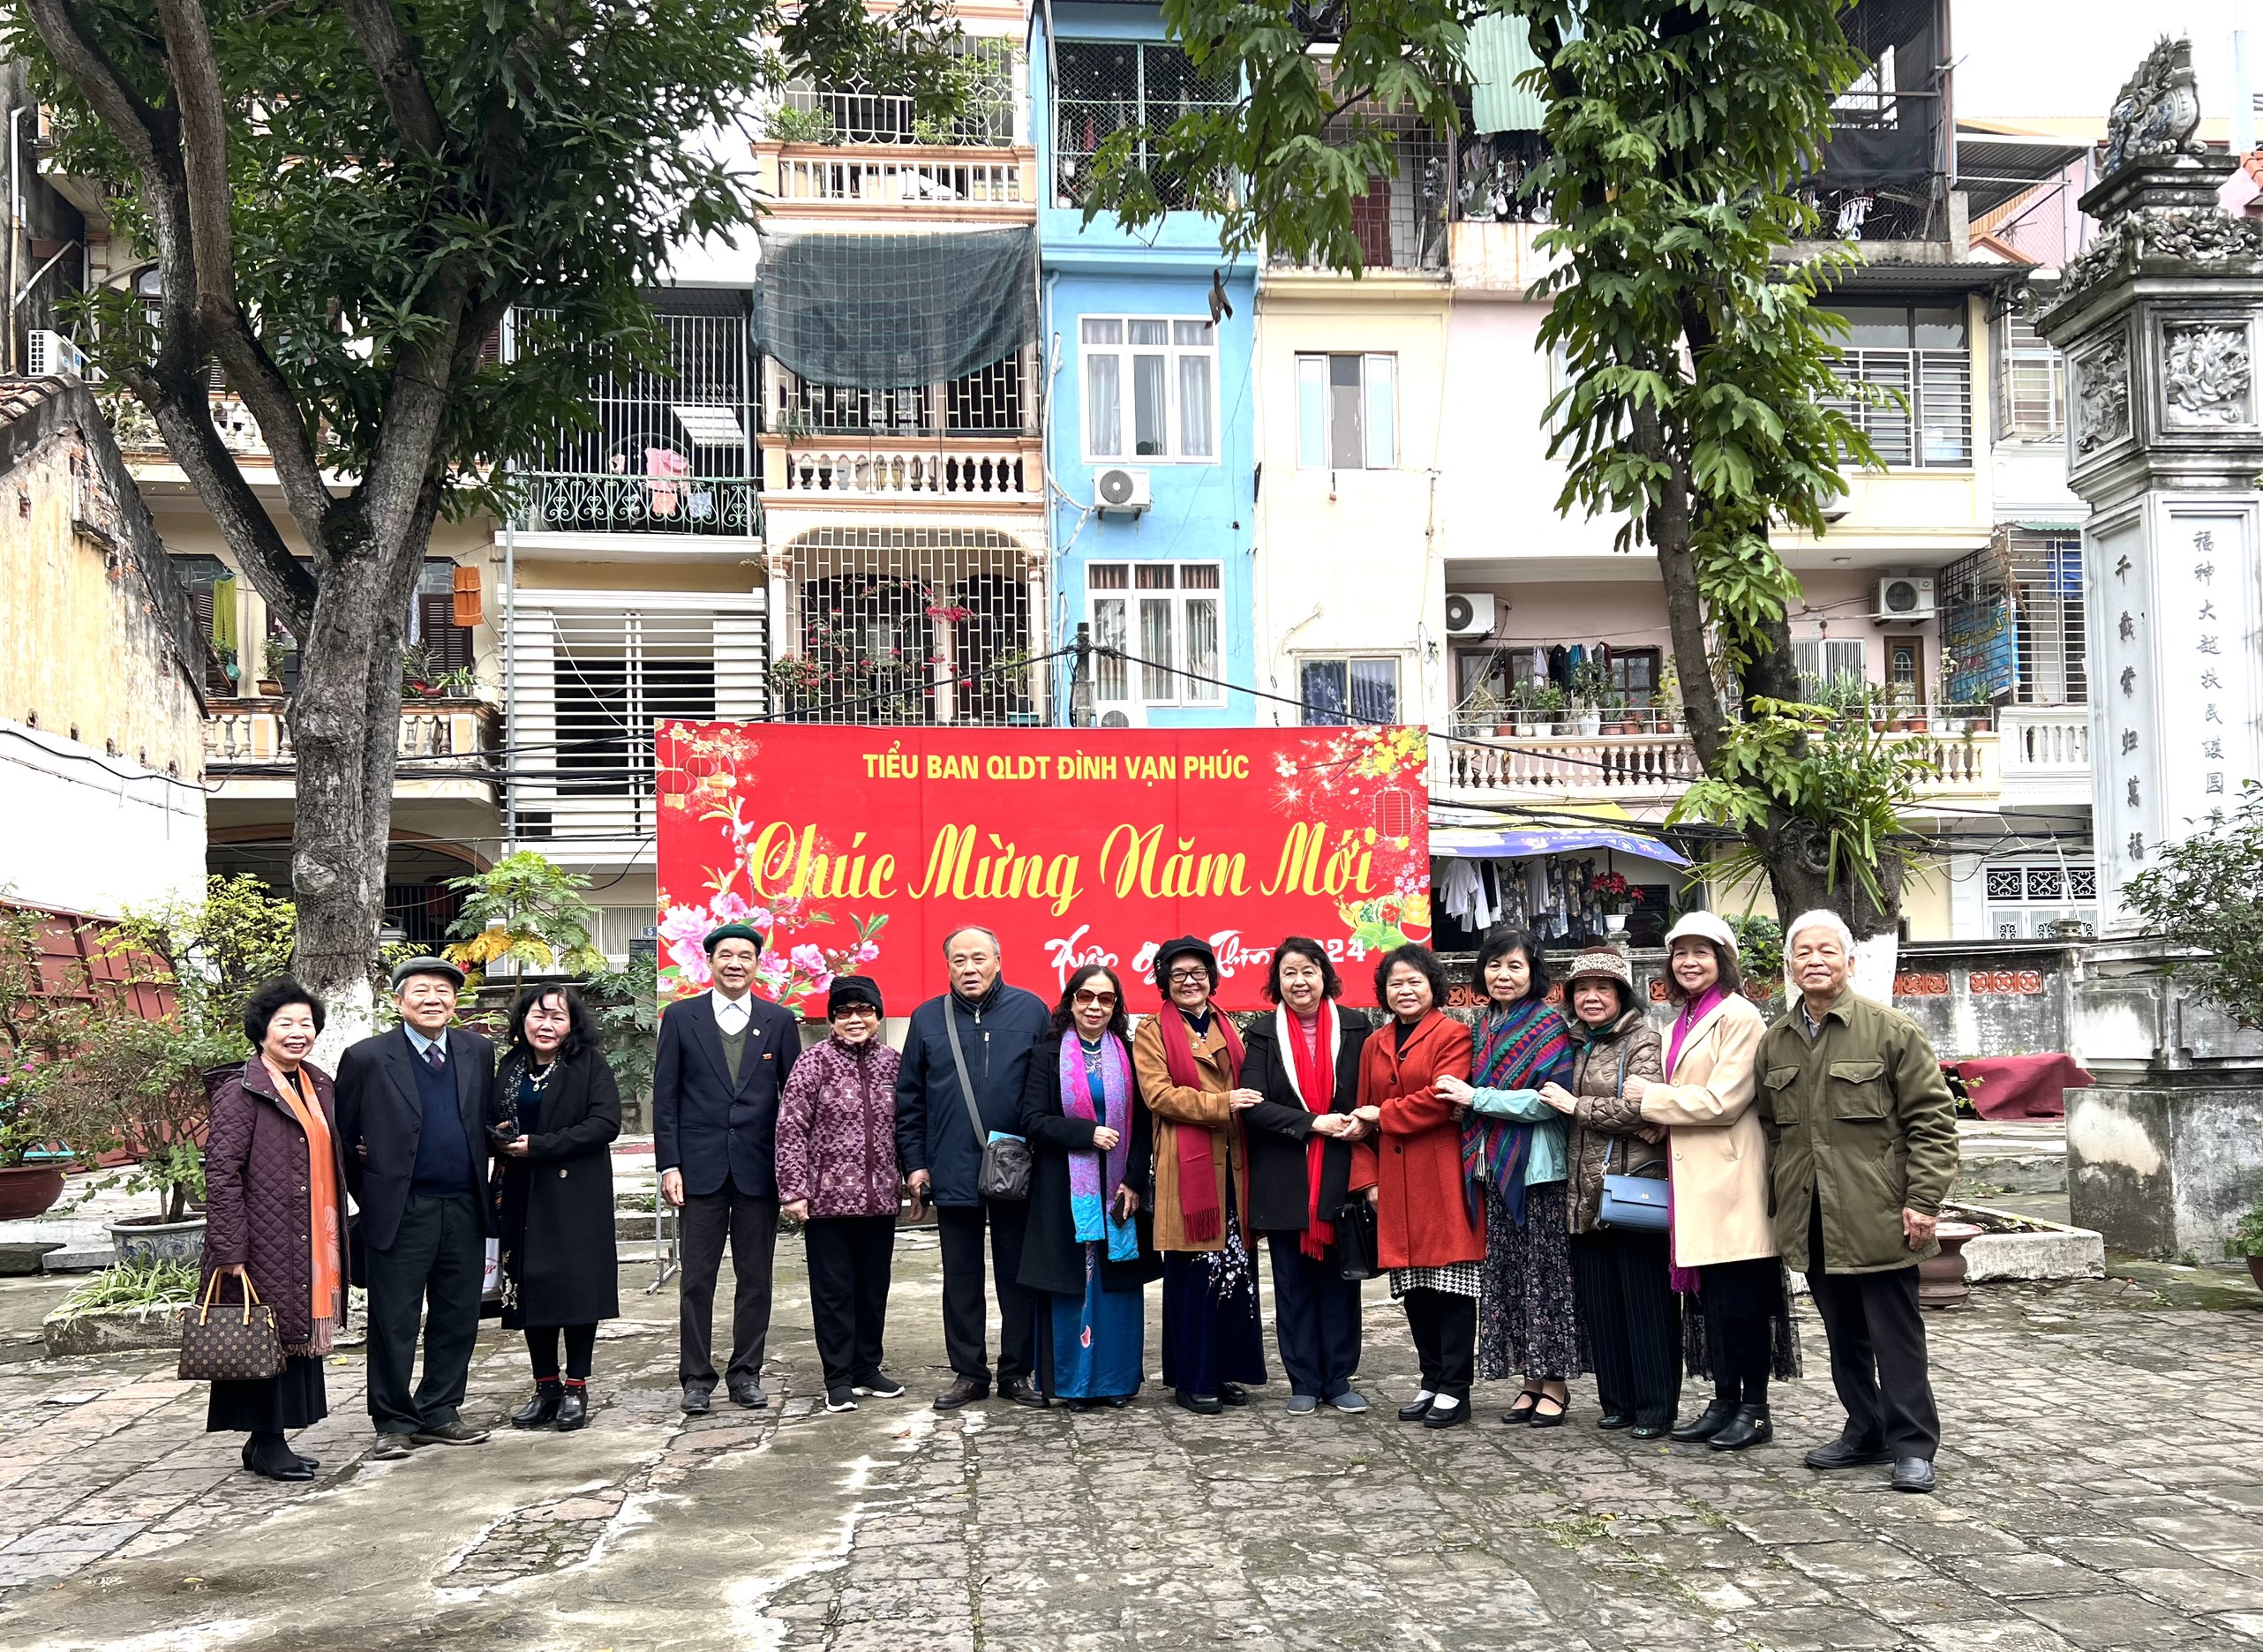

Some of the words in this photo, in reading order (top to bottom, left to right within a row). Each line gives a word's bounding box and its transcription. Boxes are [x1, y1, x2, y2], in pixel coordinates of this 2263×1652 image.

[862, 740, 919, 779] TIỂU
[927, 755, 979, 779] BAN
[986, 755, 1051, 780] QLDT
[1056, 749, 1117, 780] ĐÌNH
[1124, 755, 1177, 787] VẠN
[1184, 748, 1250, 779] PHÚC
[751, 821, 898, 900] Chúc
[907, 823, 1084, 917] Mừng
[1099, 822, 1252, 899] Năm
[1259, 821, 1377, 897] Mới
[647, 927, 653, 936] 5
